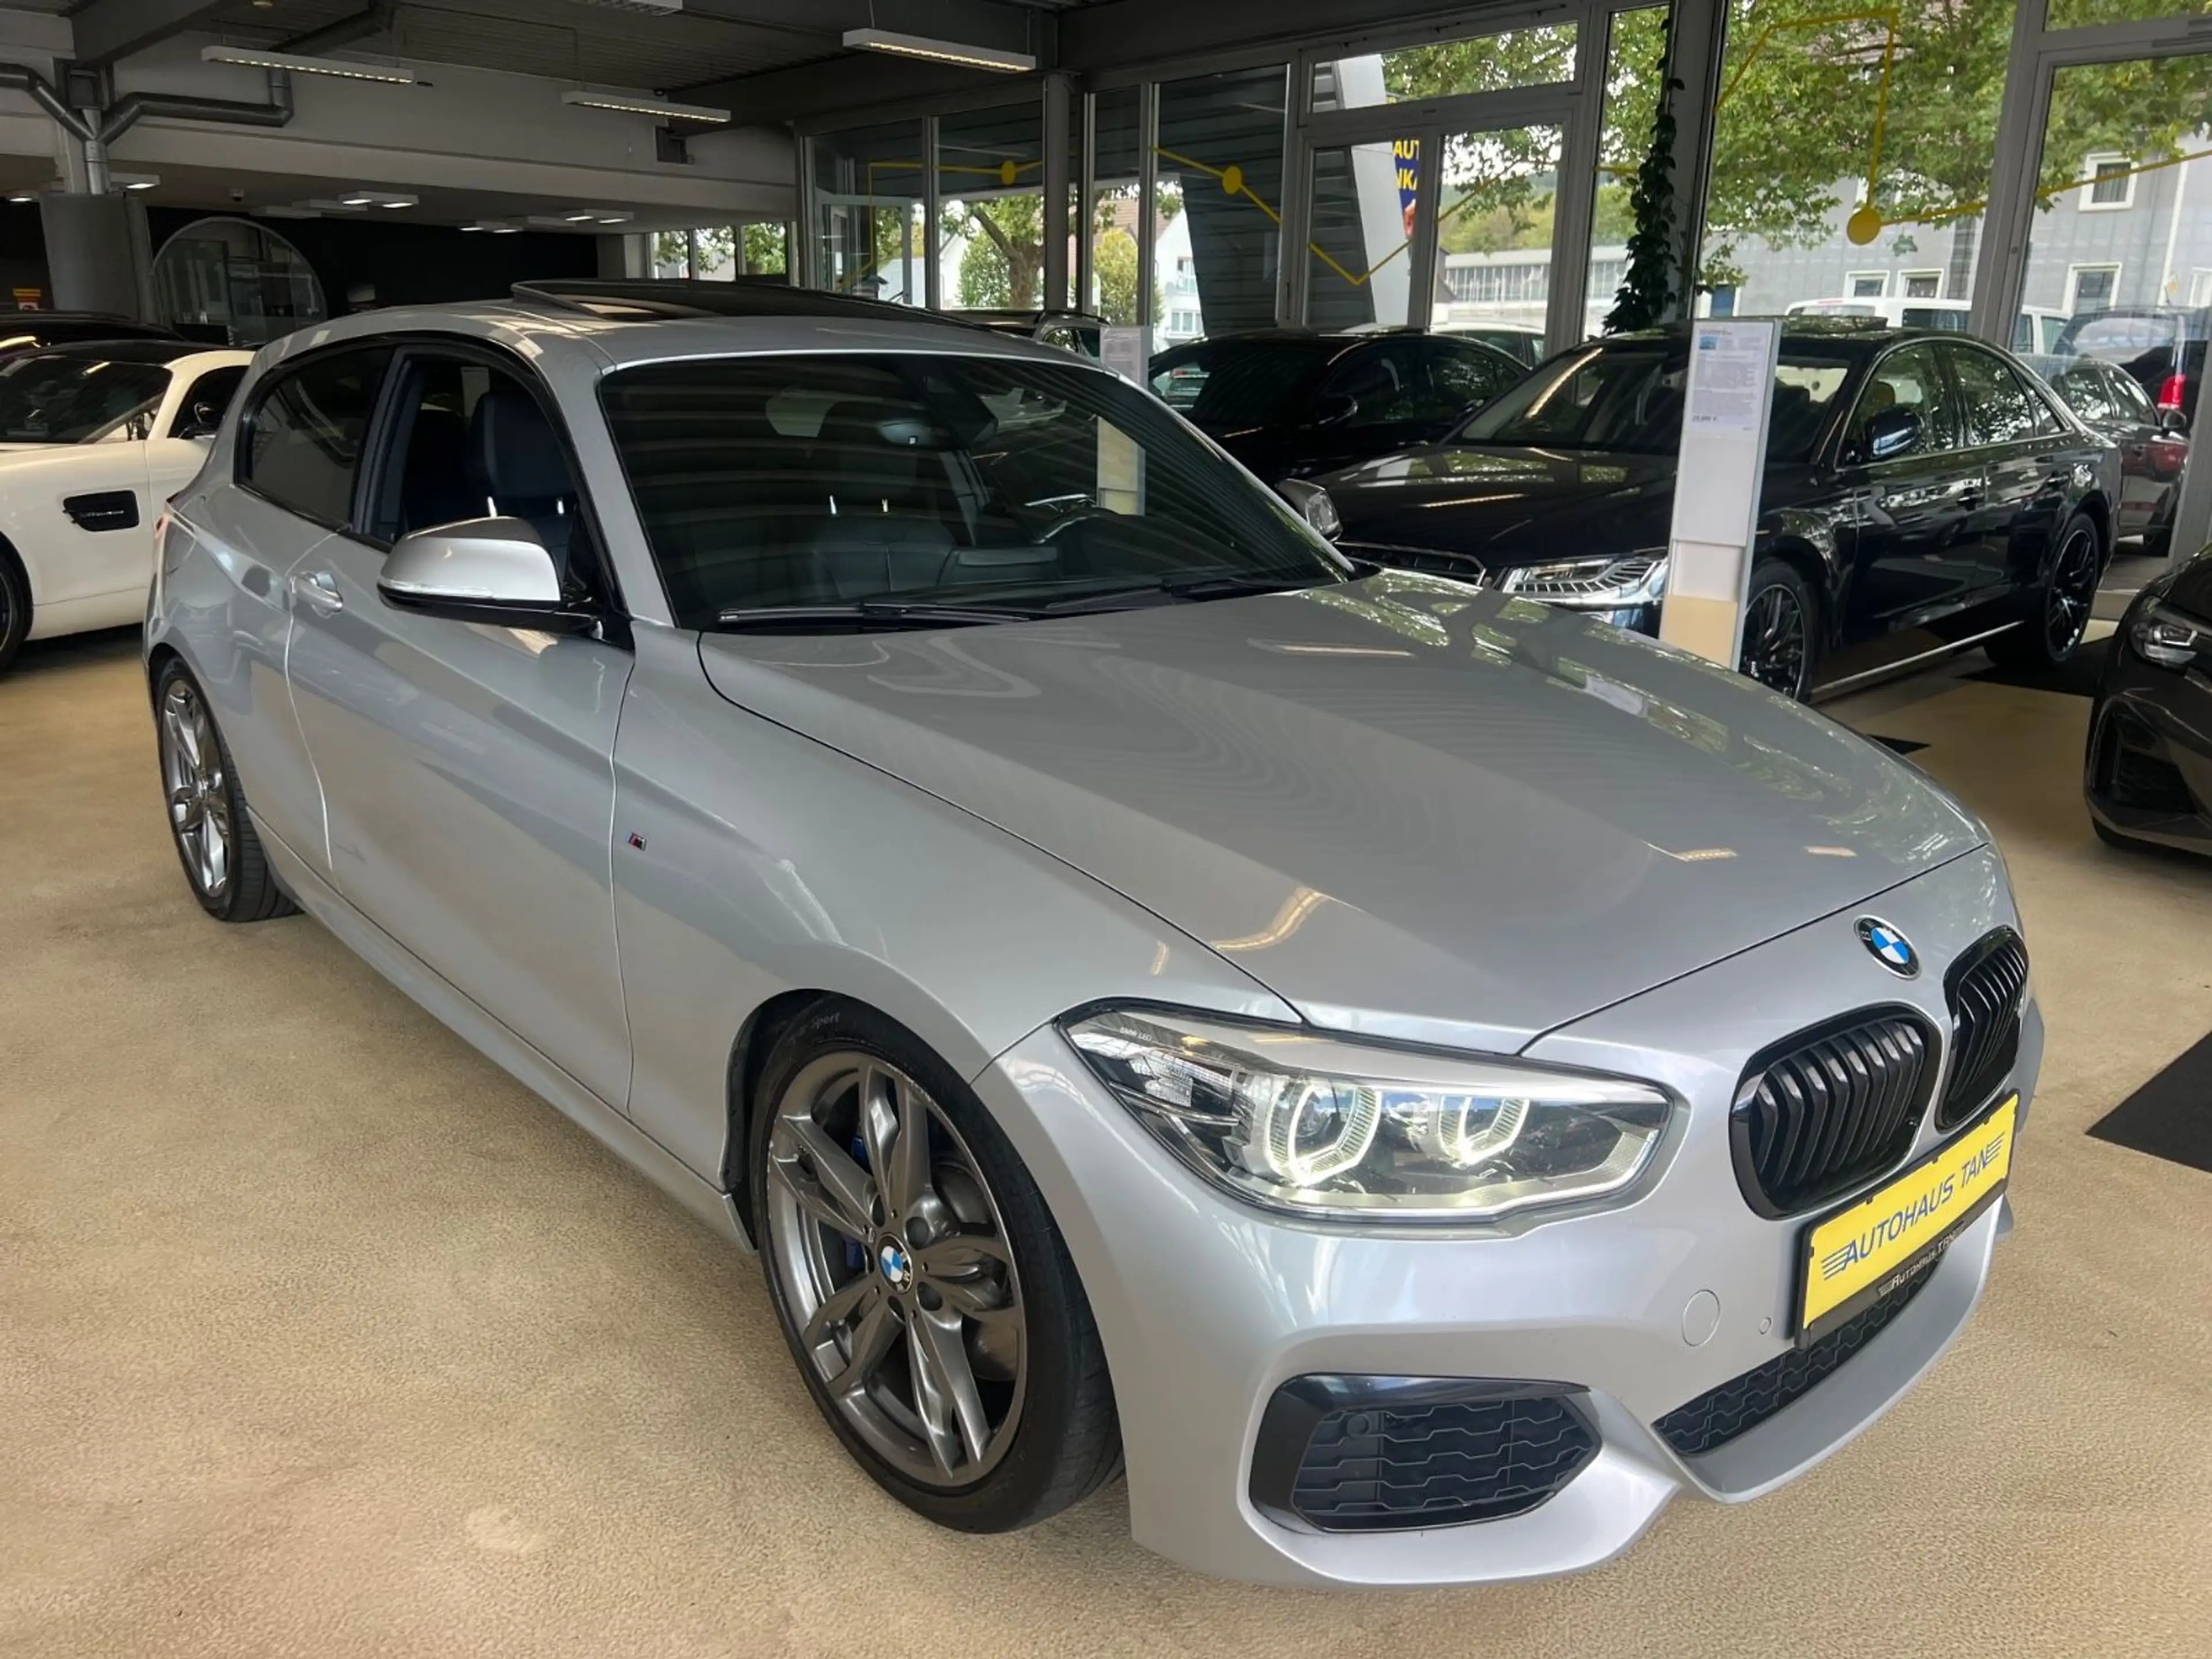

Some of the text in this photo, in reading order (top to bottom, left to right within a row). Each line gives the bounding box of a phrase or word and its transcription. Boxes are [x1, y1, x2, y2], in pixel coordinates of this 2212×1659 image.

[1120, 1027, 1152, 1041] BMW LED
[1840, 1144, 1991, 1271] AUTOHAUS TAN
